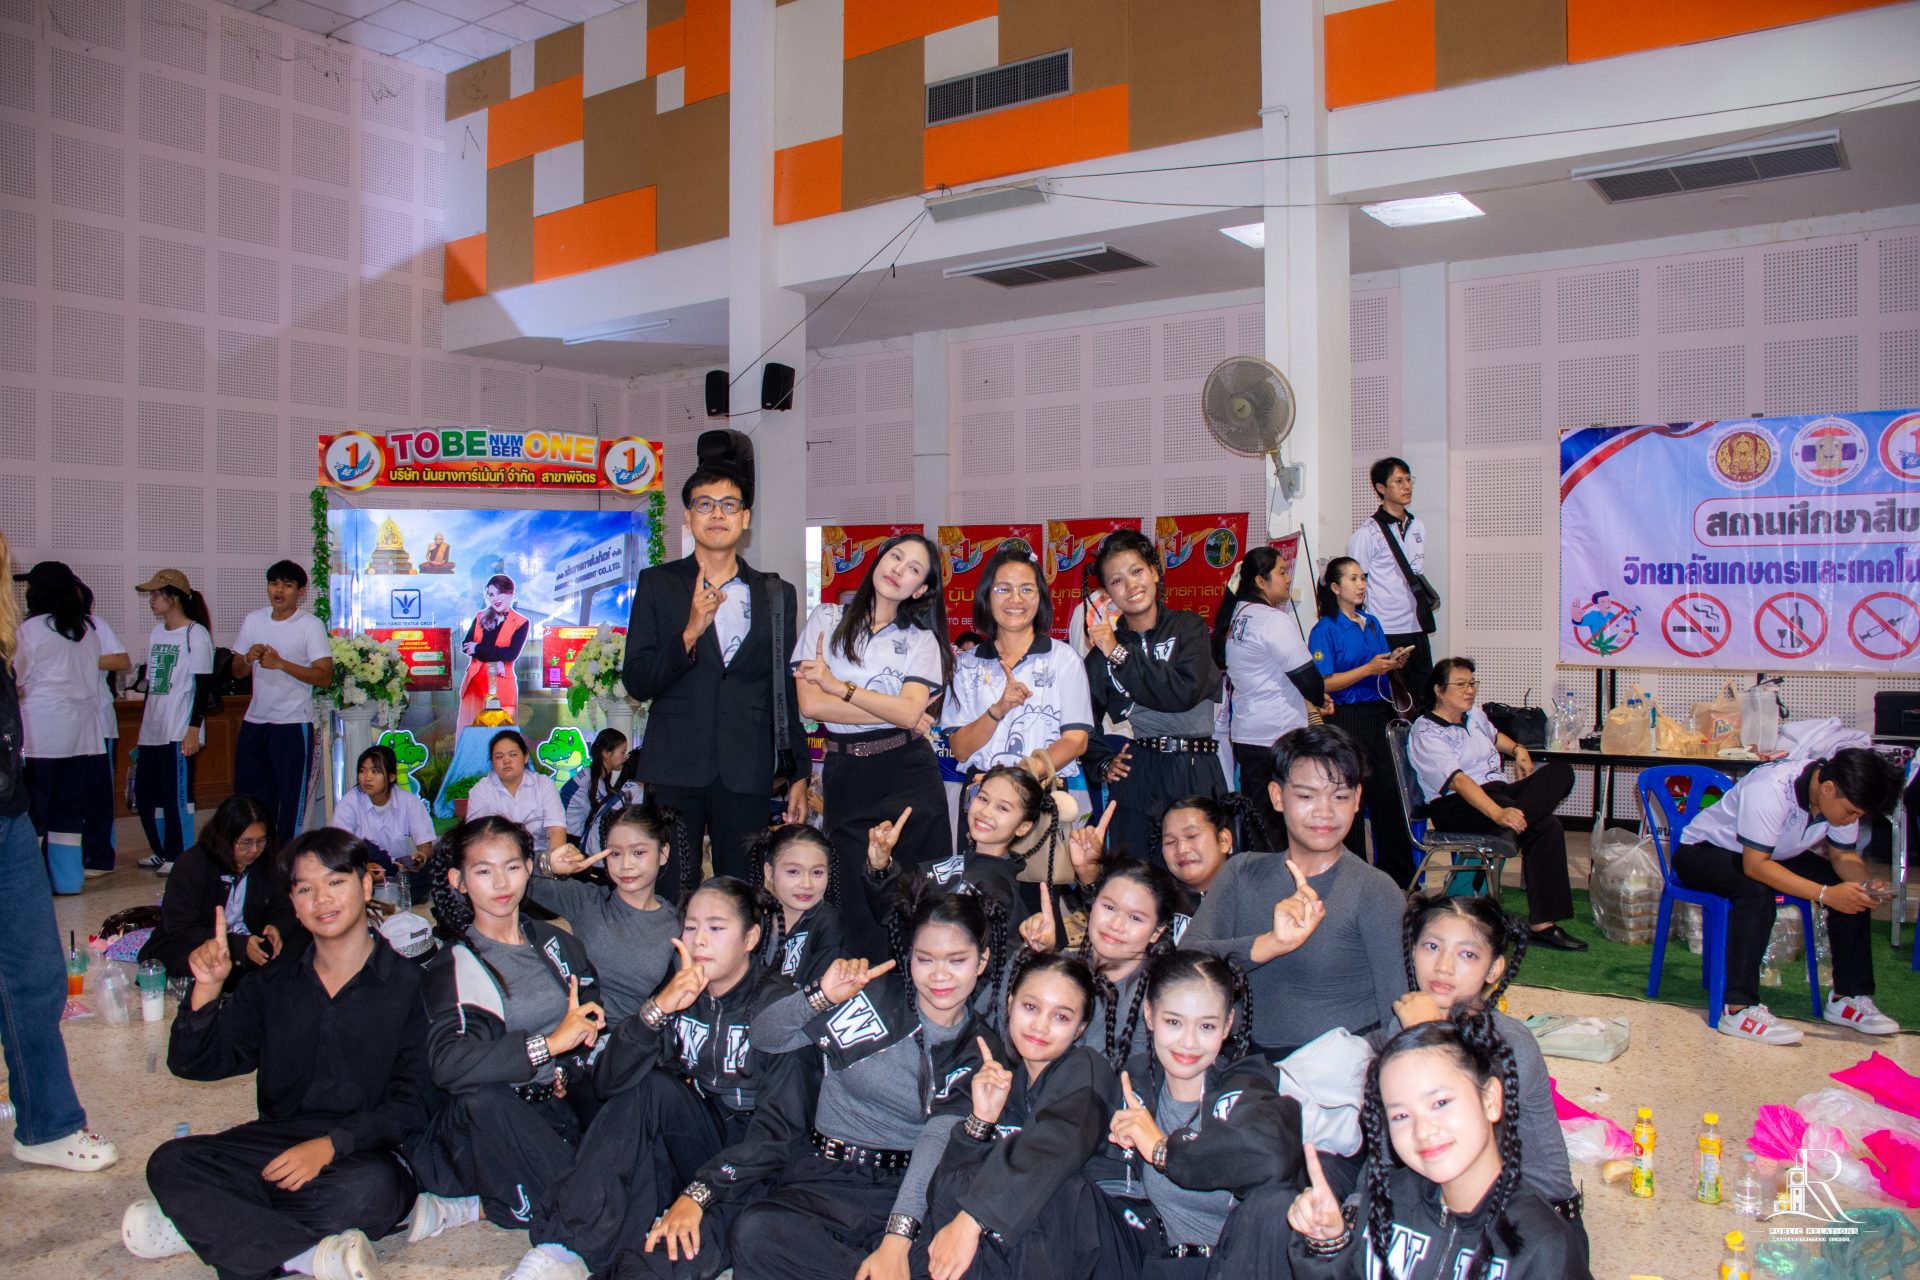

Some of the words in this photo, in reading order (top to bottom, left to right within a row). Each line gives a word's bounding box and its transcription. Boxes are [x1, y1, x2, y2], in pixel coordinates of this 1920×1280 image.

[489, 434, 523, 446] NUM
[524, 431, 598, 463] ONE
[491, 446, 521, 457] BER
[389, 467, 420, 481] บริษัท
[423, 466, 504, 482] นันยางการ์เม้นท์
[507, 468, 535, 483] จำกัด
[541, 470, 596, 484] สาขาพิจิตร
[1198, 605, 1210, 617] 2
[961, 617, 973, 625] BE
[827, 990, 889, 1049] W
